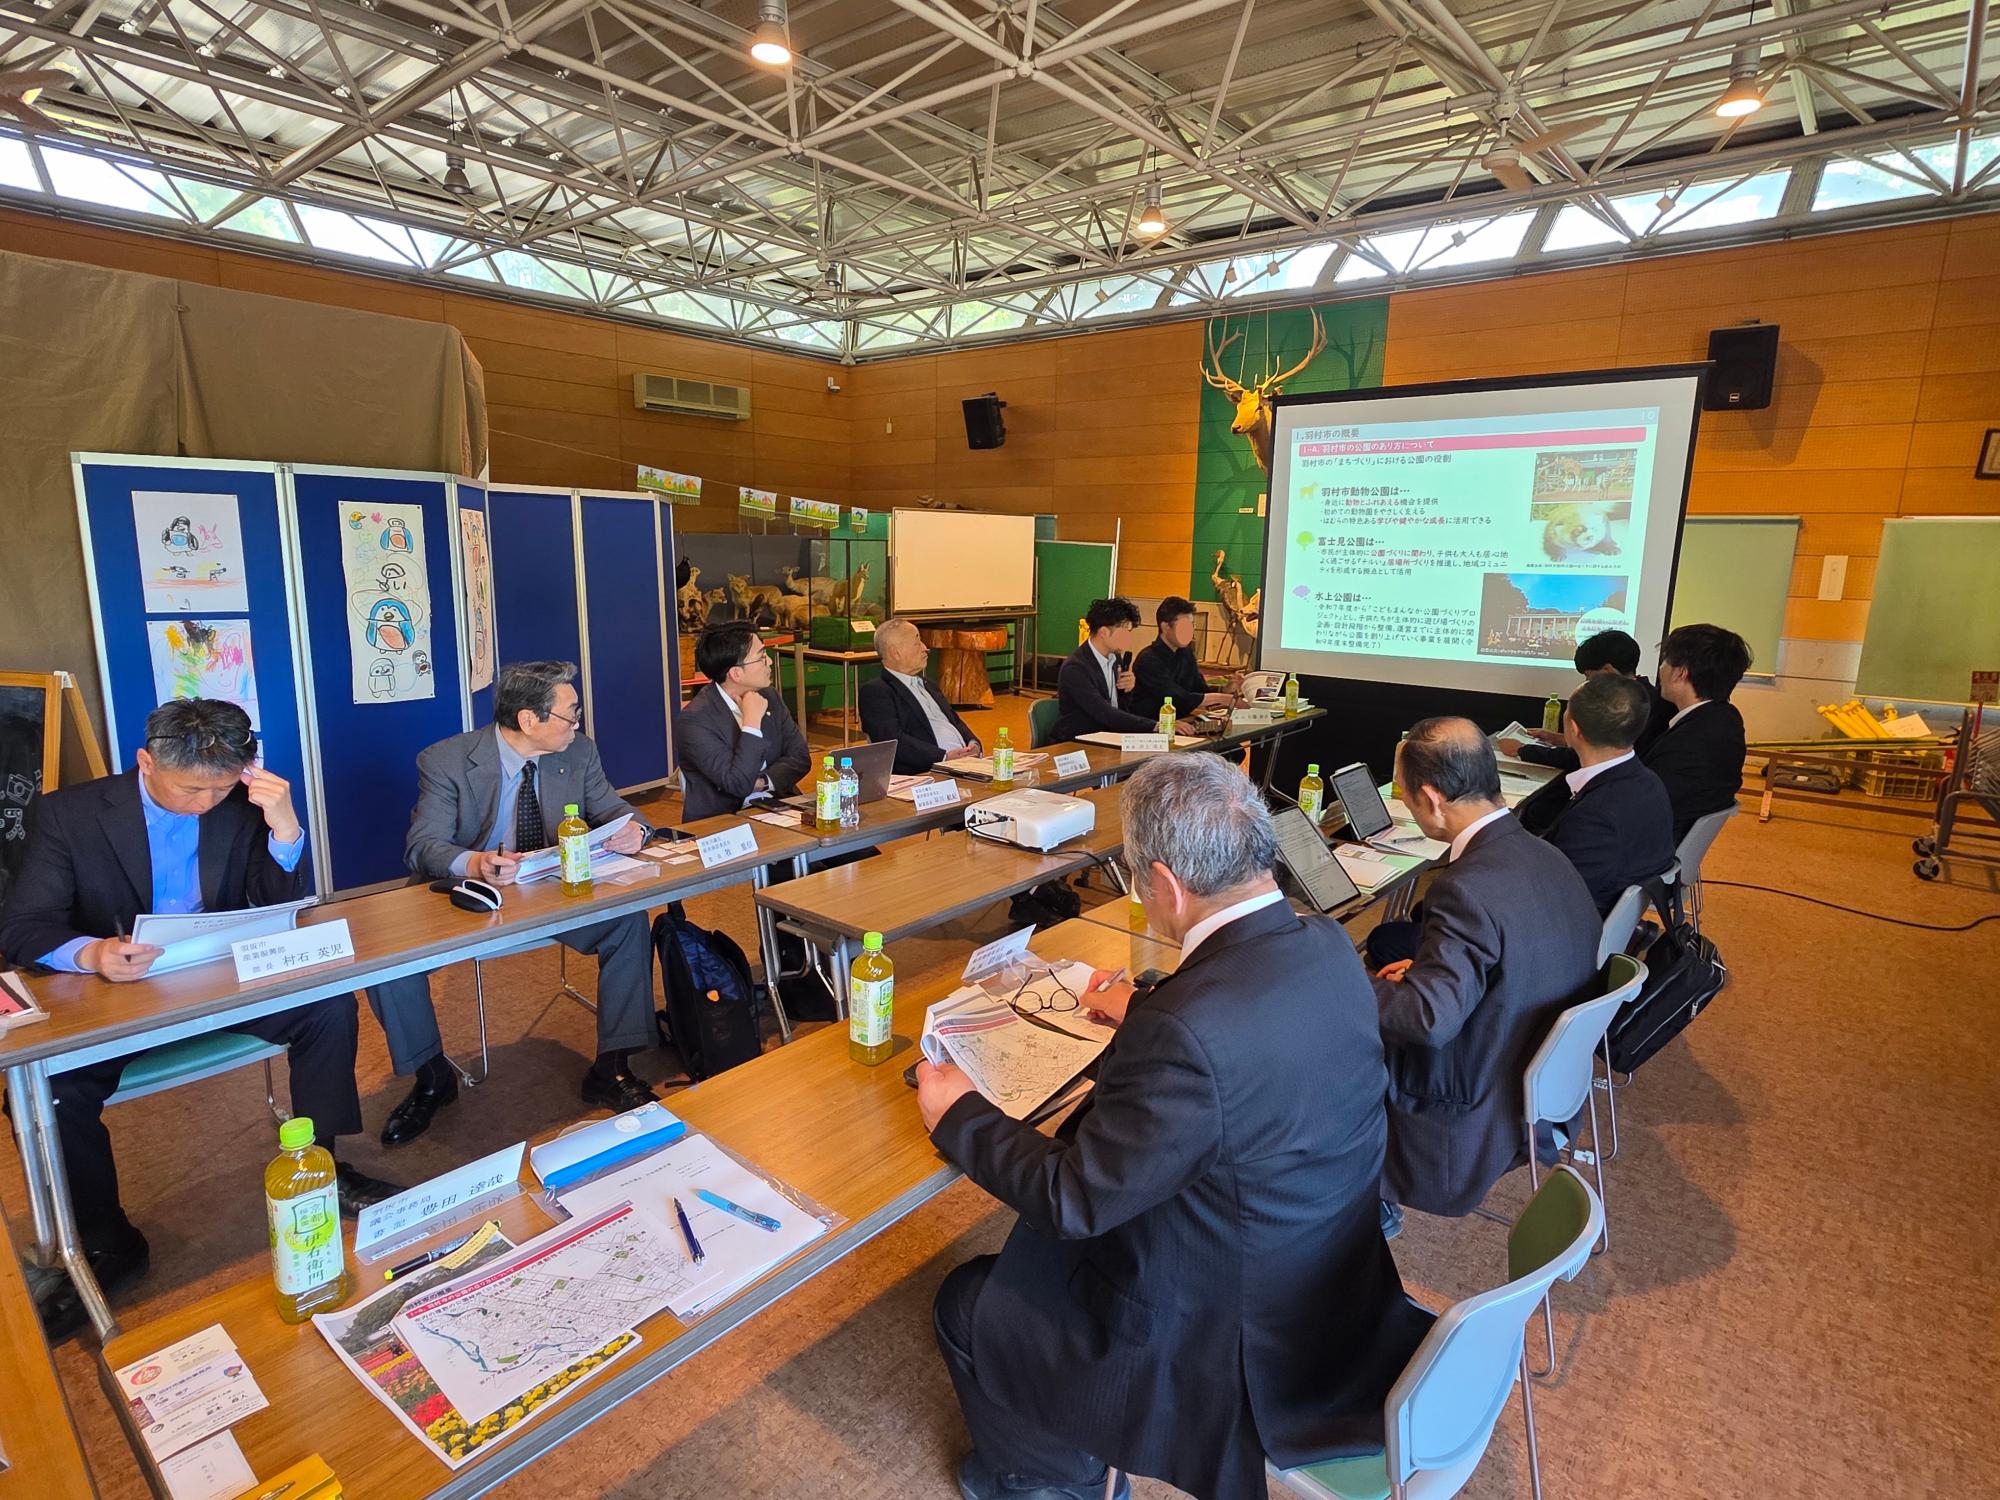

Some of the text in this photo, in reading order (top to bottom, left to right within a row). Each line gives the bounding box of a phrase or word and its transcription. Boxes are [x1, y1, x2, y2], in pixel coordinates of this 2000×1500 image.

[283, 951, 310, 967] 村石
[318, 943, 344, 960] 英児
[421, 1194, 458, 1217] 豊田
[304, 1232, 324, 1286] 伊右衛門
